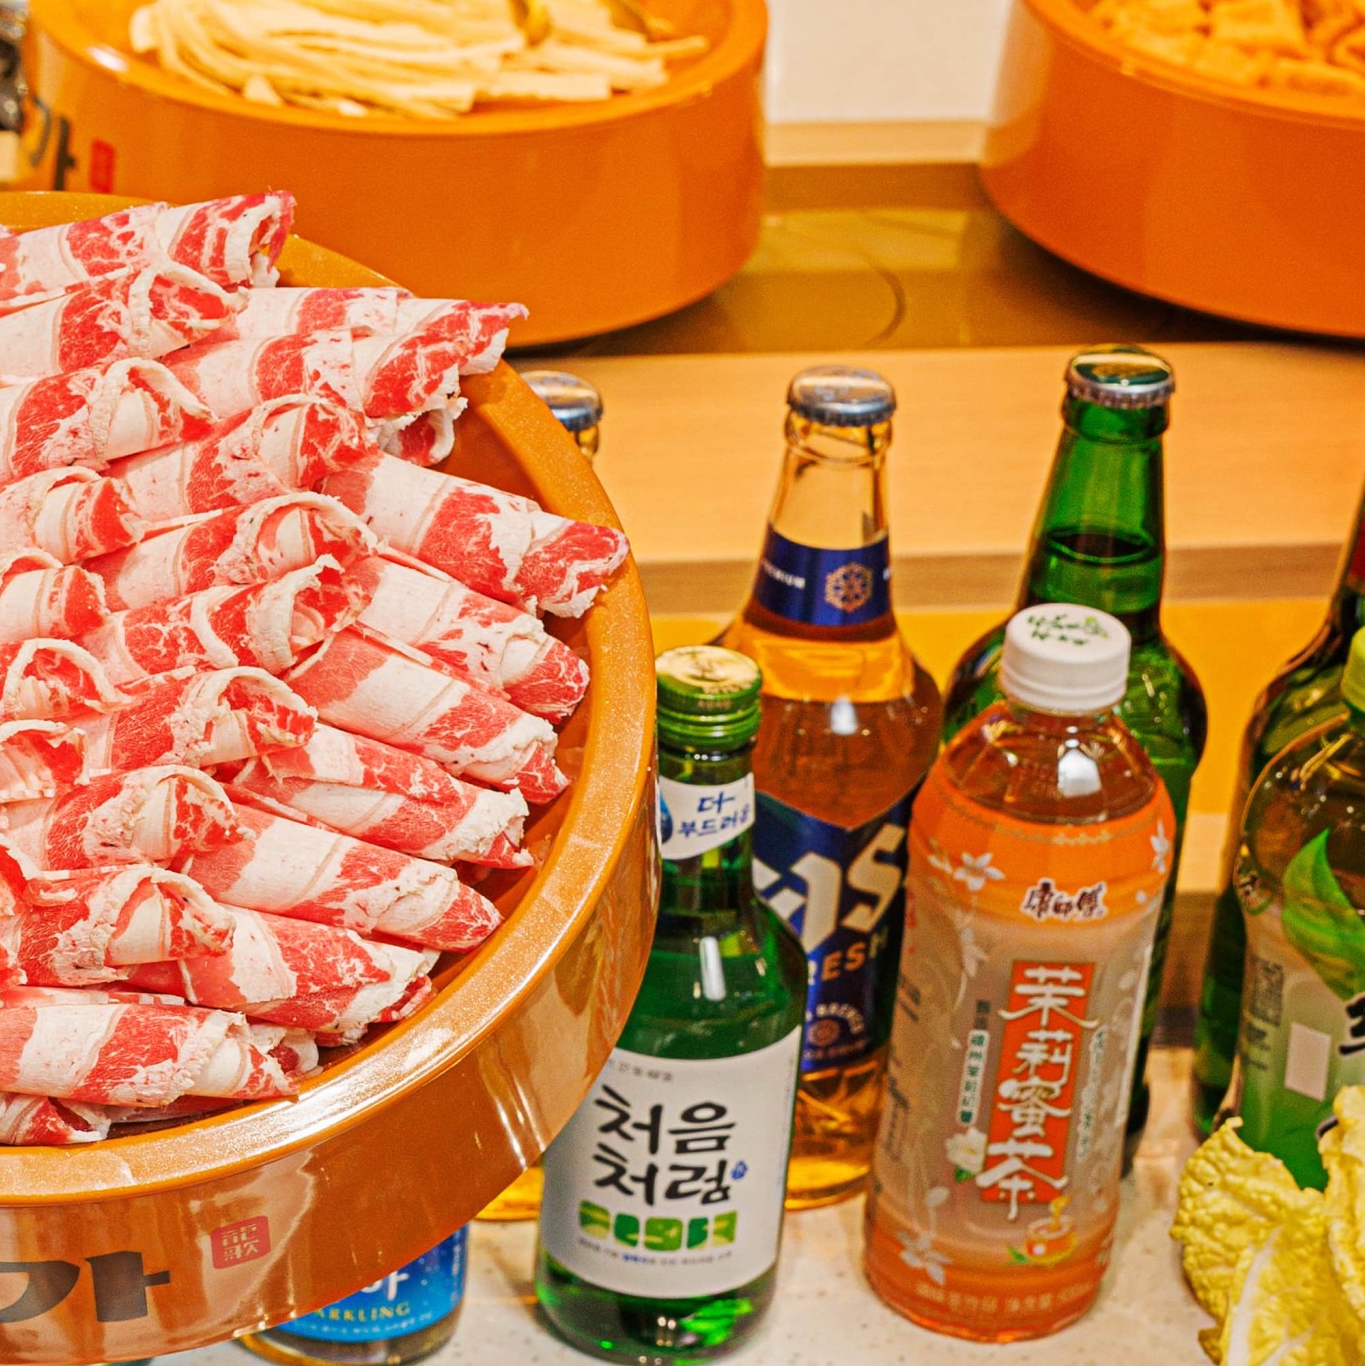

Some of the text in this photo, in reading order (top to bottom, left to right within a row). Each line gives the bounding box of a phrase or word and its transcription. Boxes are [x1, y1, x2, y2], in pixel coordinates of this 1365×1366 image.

[697, 791, 737, 814] 더
[593, 1083, 738, 1156] 처음
[975, 966, 1099, 1222] 茉莉蜜茶
[592, 1141, 732, 1207] 처럼
